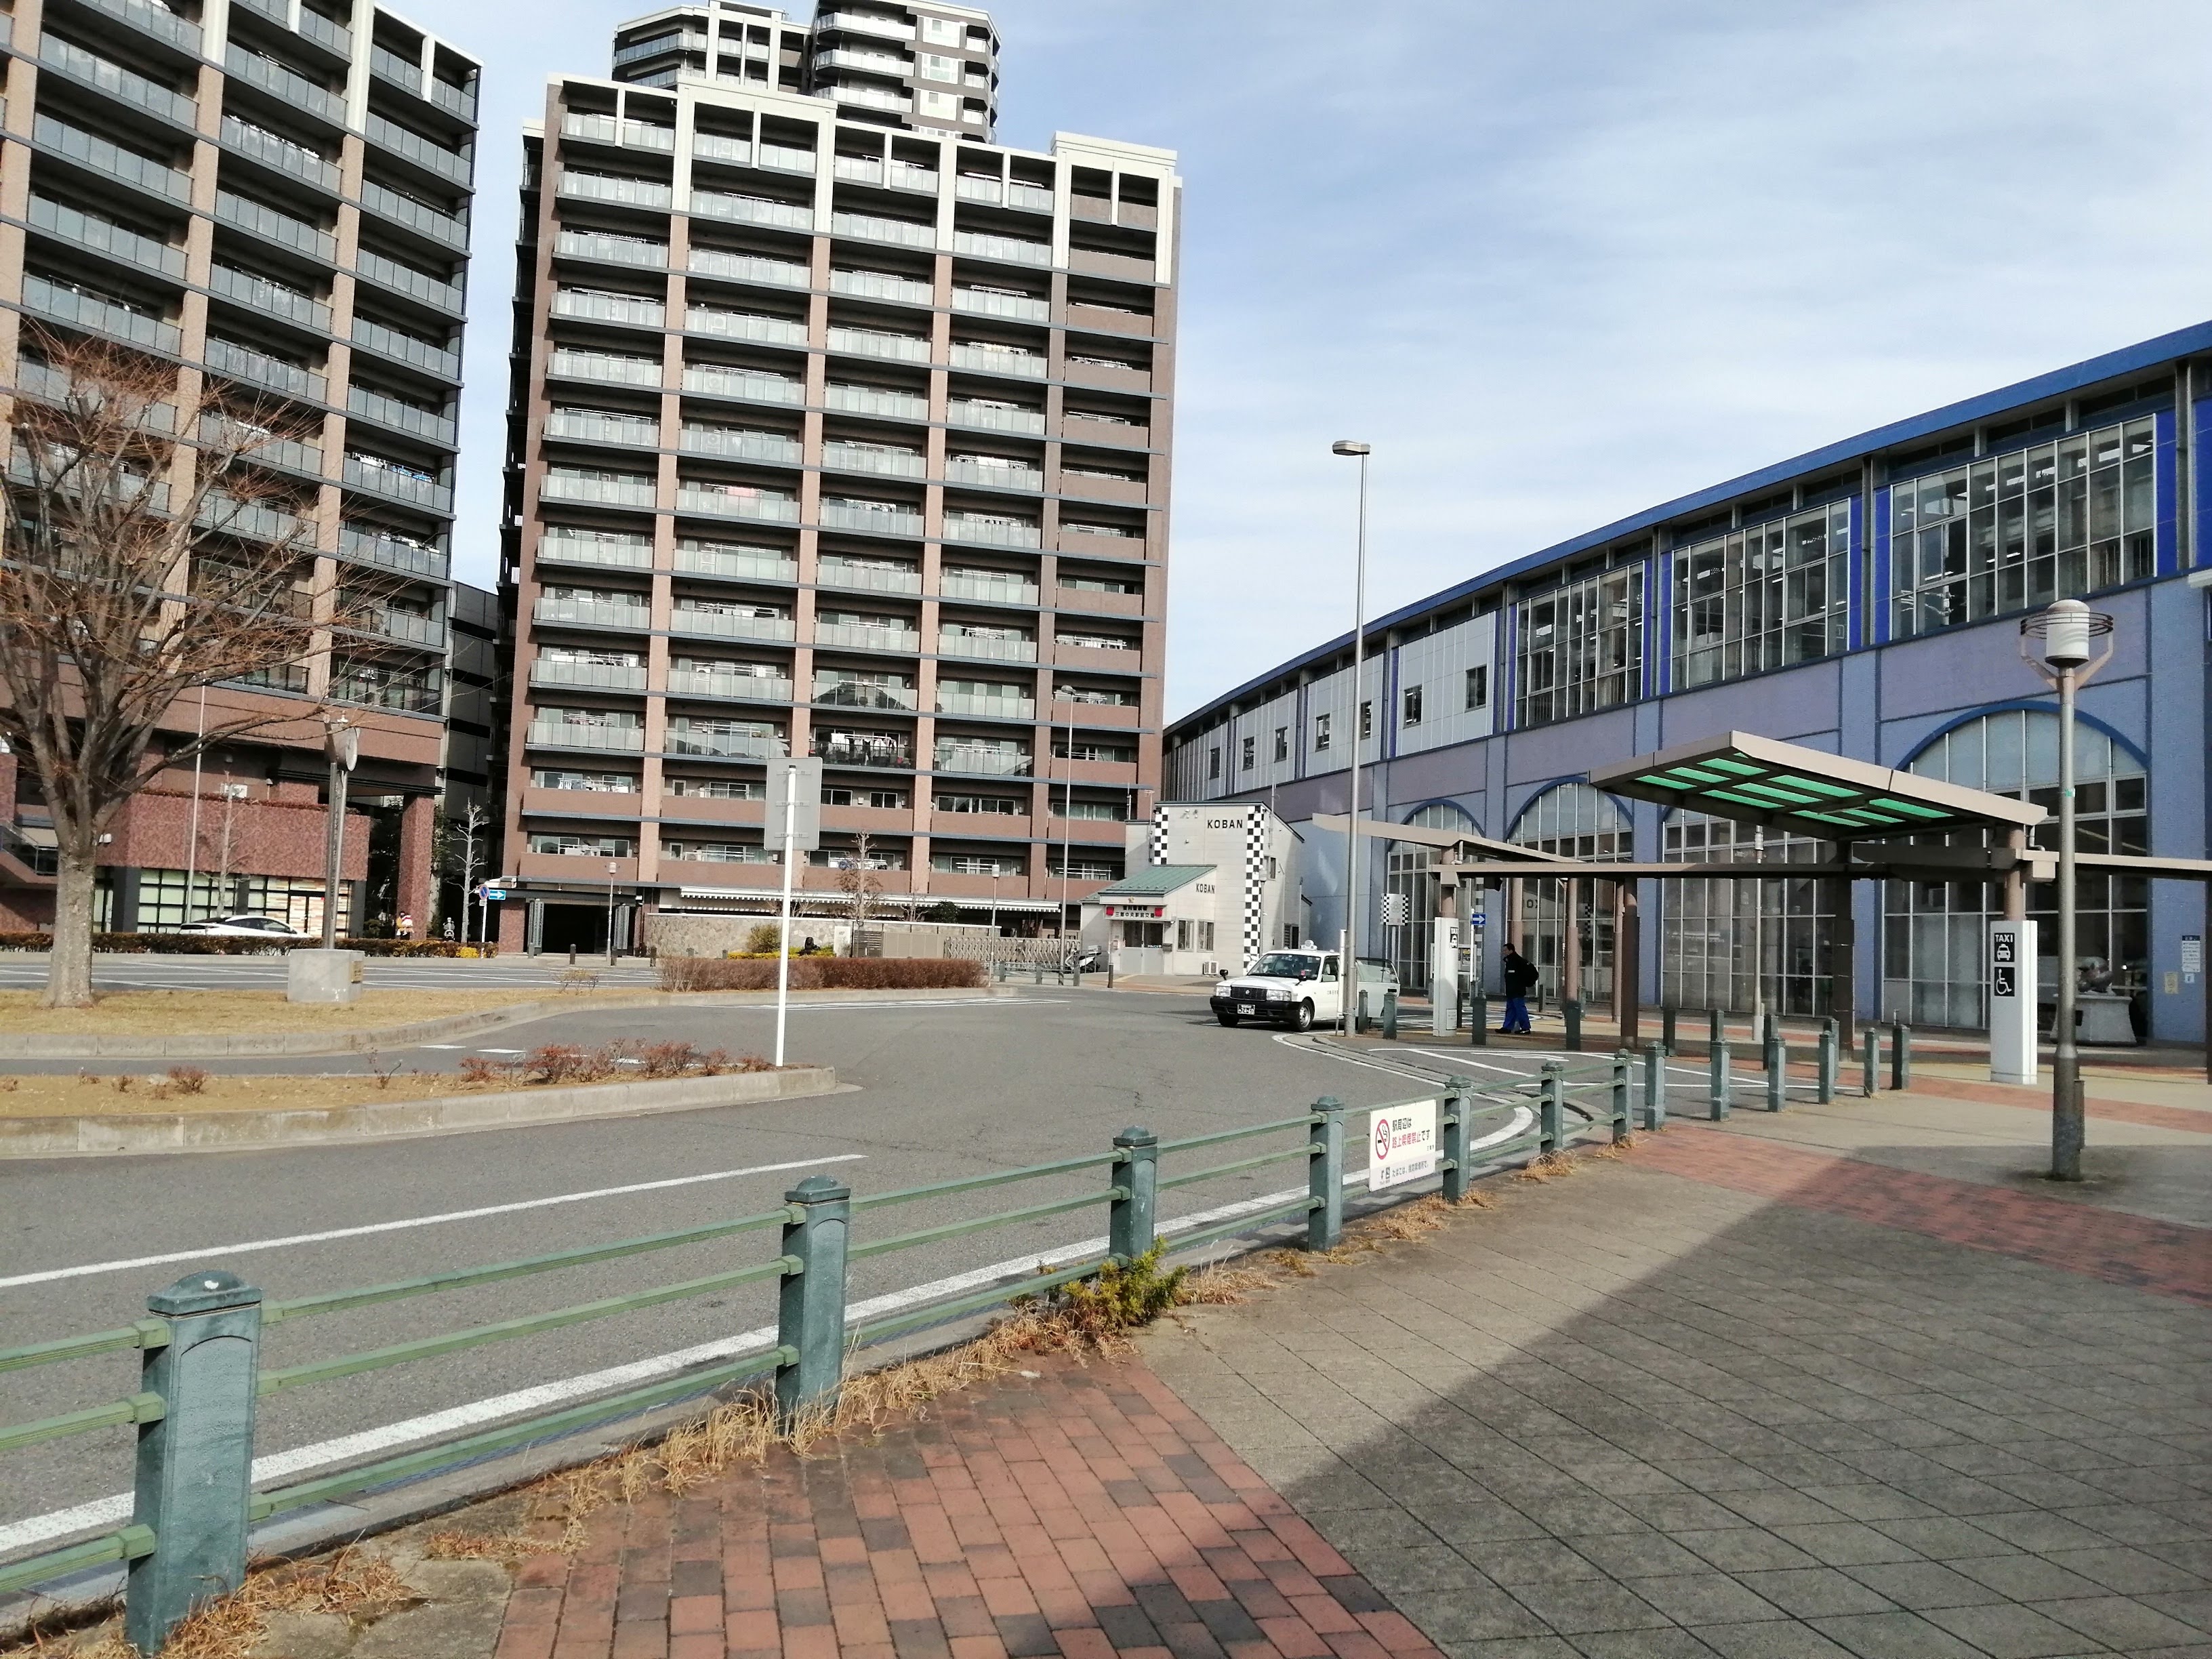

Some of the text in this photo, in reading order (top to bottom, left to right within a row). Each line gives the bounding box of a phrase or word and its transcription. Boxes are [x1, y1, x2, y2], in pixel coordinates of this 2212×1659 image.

[1208, 819, 1243, 829] KOBAN
[1196, 883, 1215, 894] KOBAN
[1995, 935, 2013, 943] TAXI
